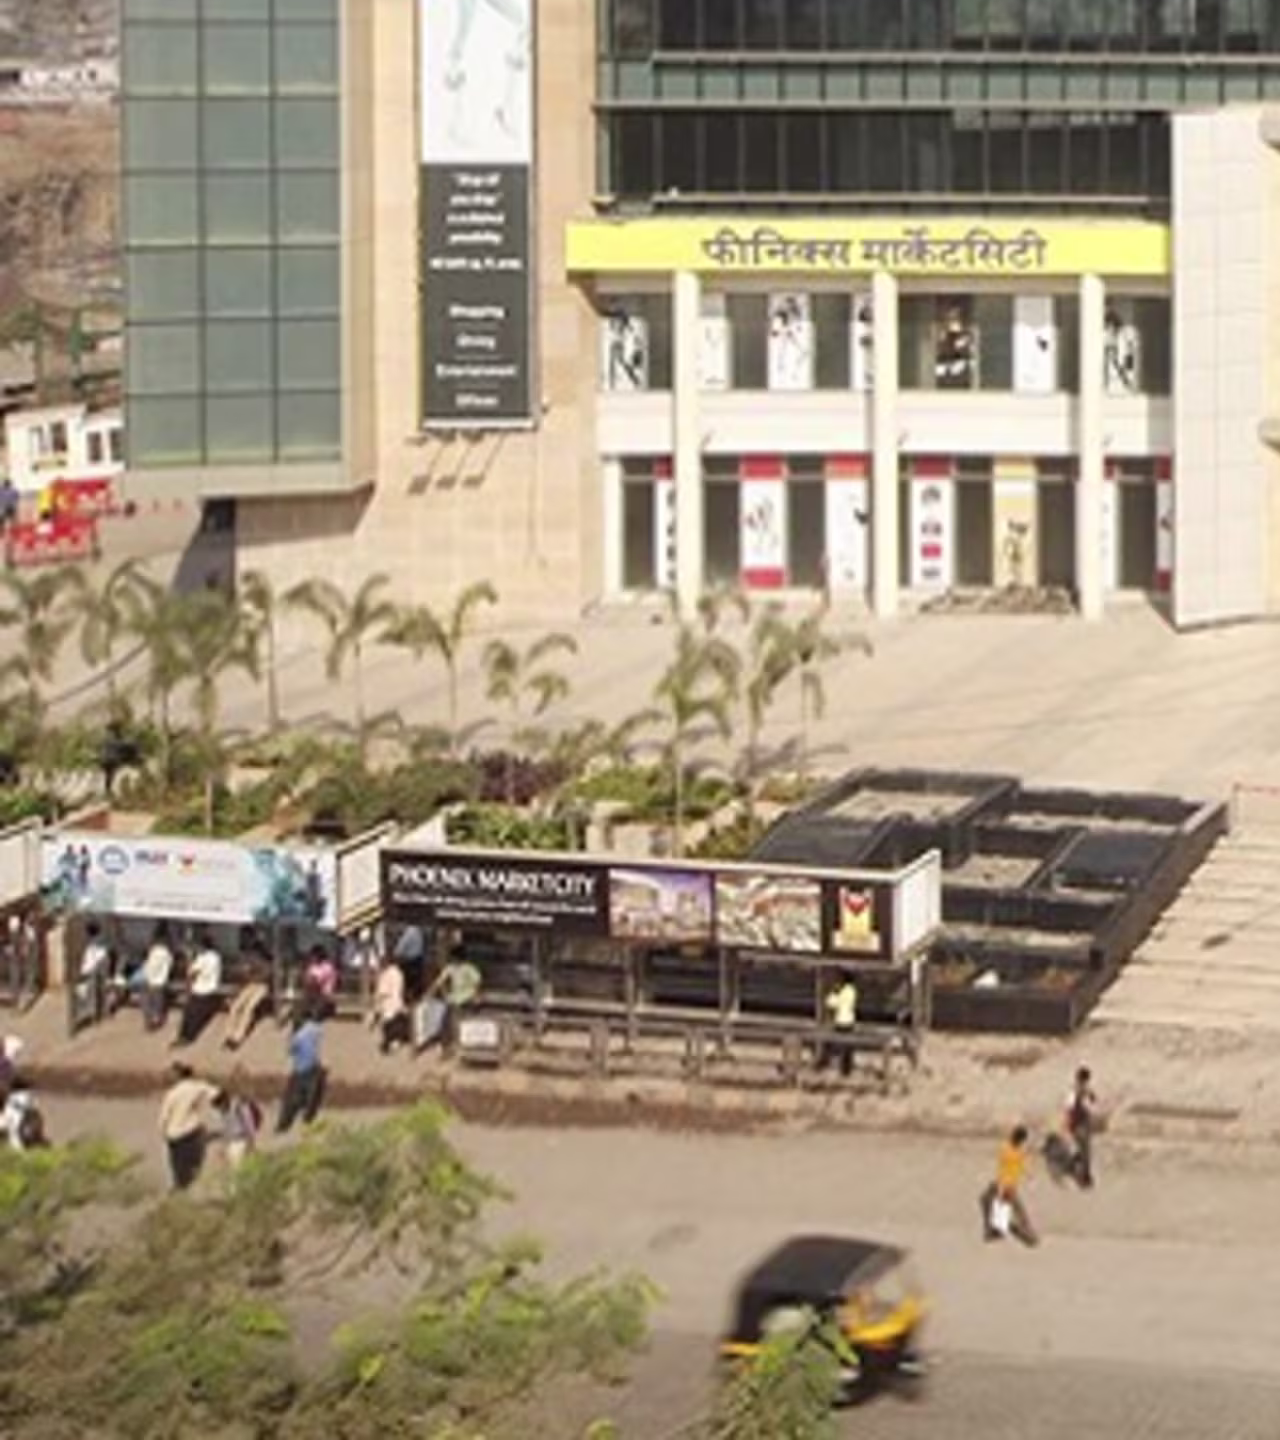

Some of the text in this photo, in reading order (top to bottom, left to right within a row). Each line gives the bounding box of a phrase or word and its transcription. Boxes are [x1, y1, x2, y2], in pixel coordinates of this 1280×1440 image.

[702, 225, 1049, 270] फीनिक्स मार्केटसिटी
[388, 863, 596, 896] PHOENIX MARKETCITY
